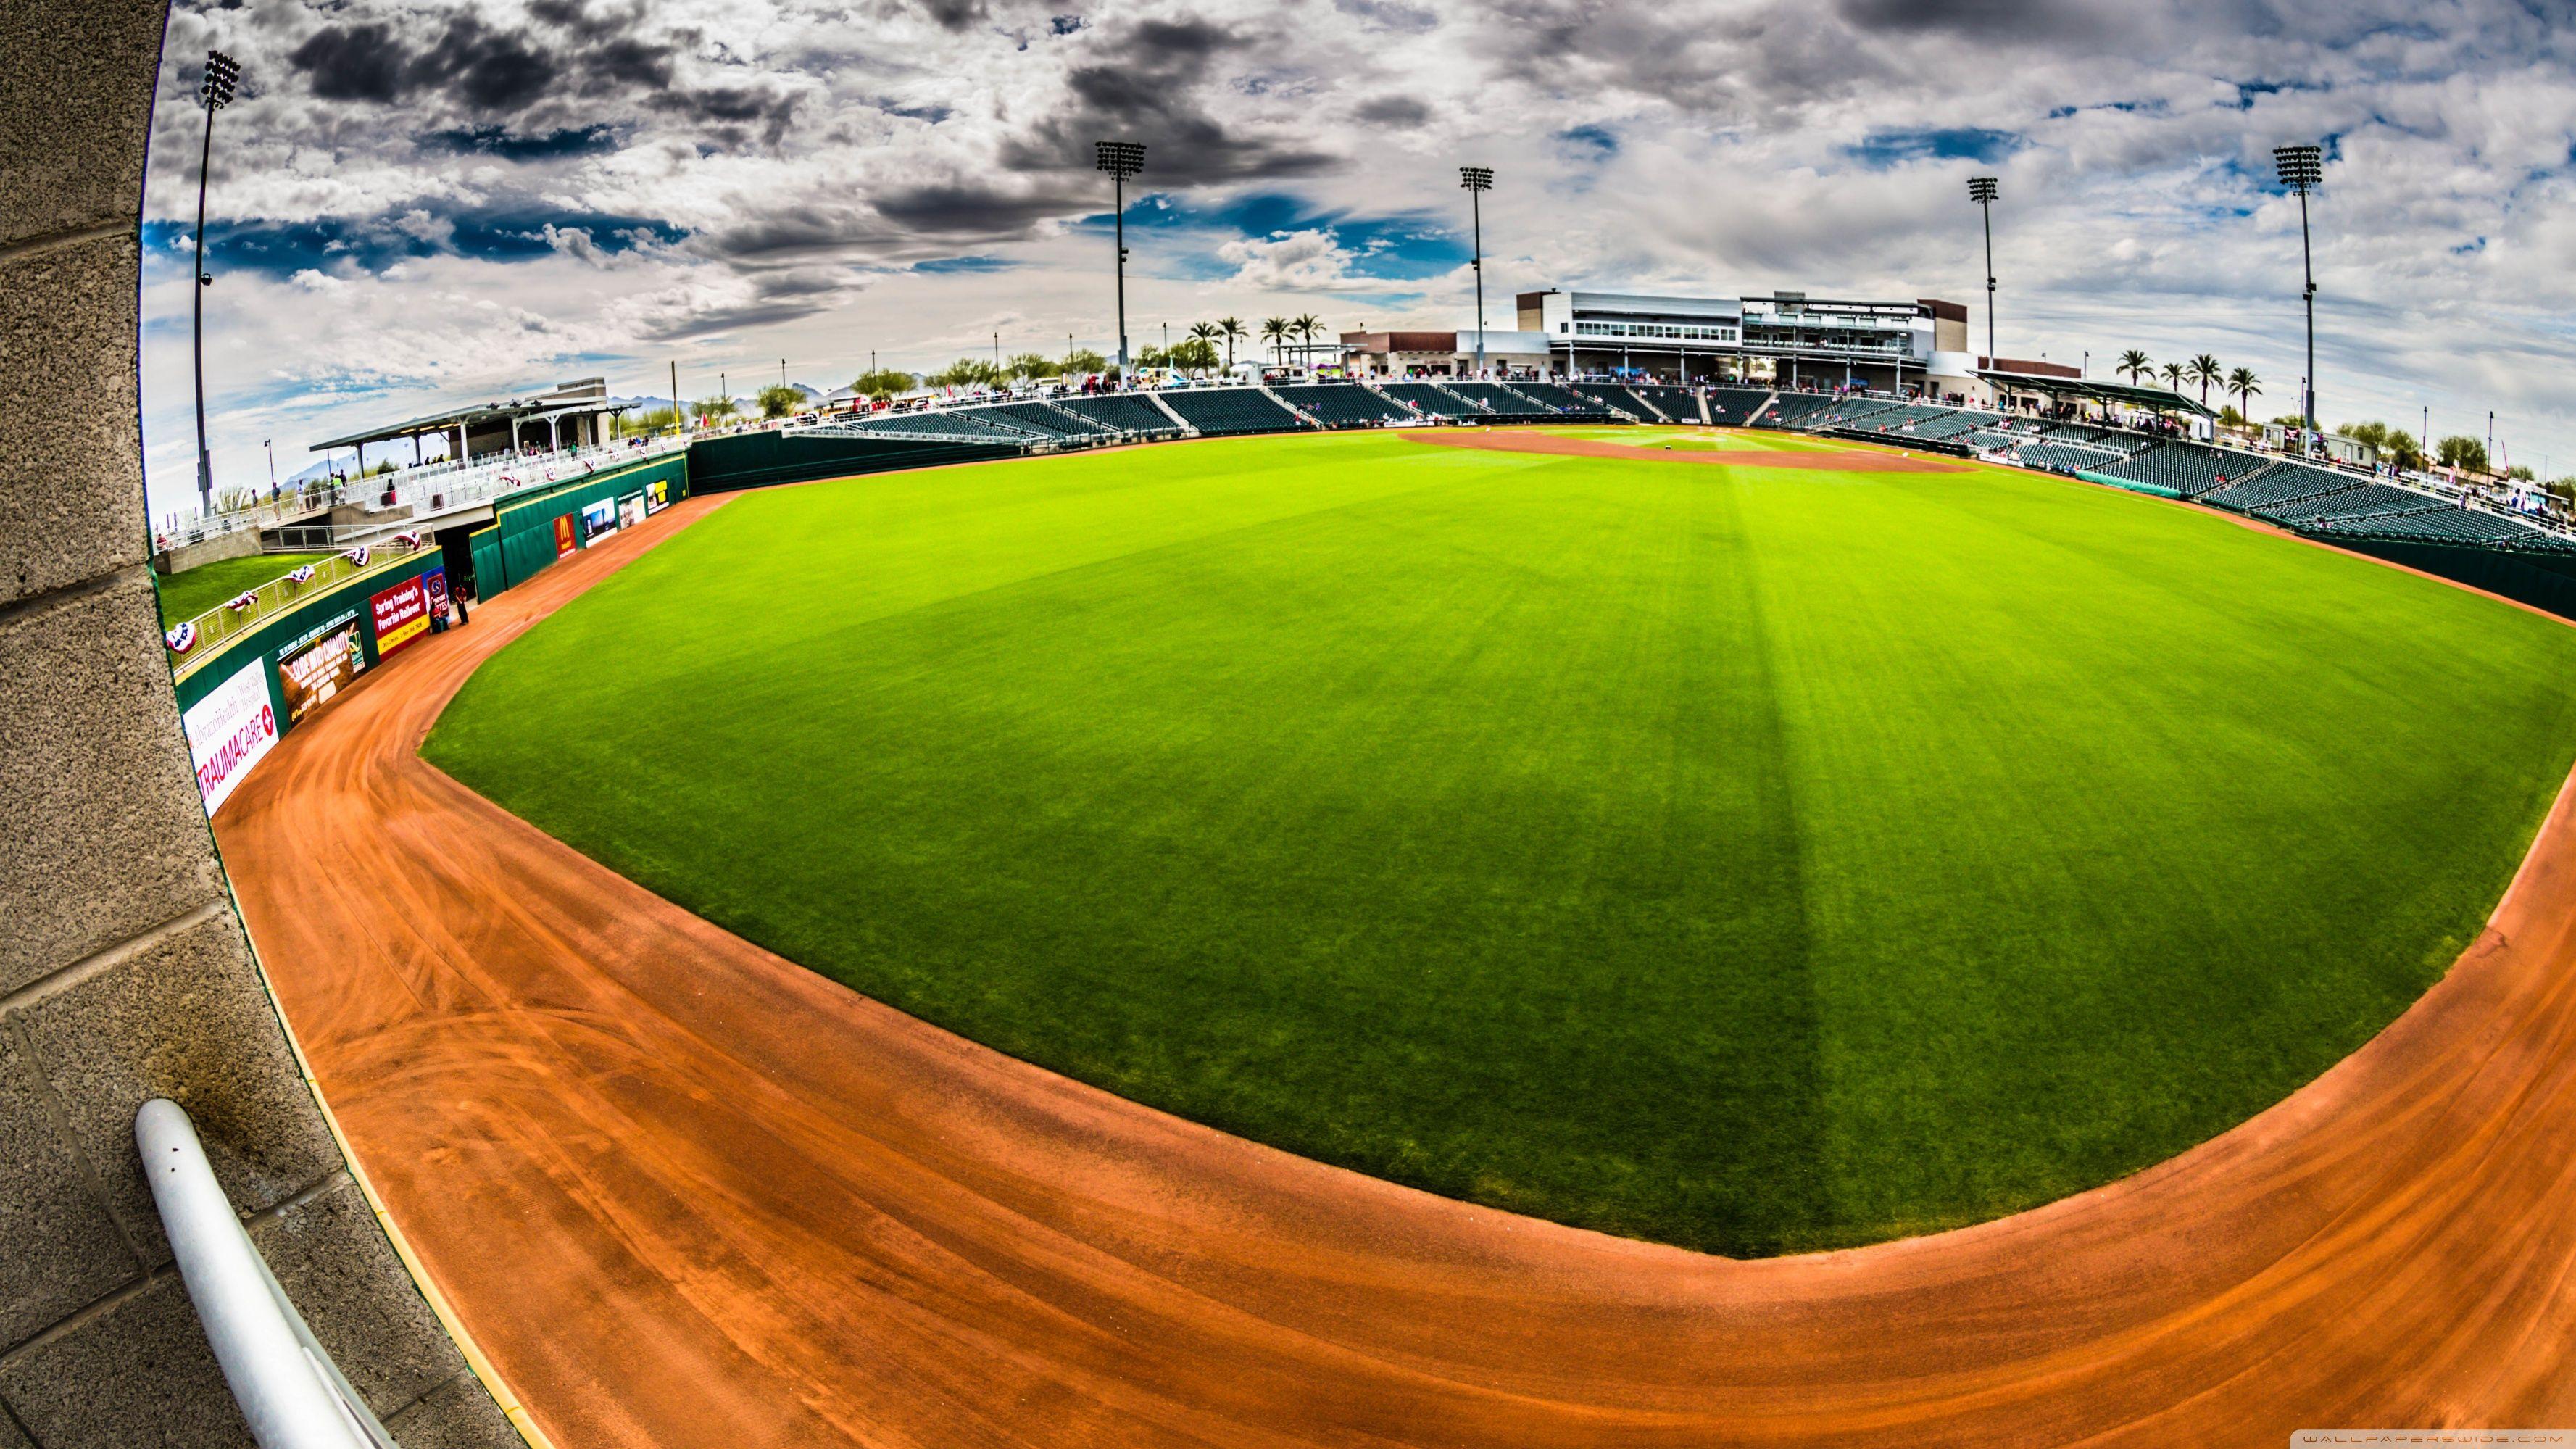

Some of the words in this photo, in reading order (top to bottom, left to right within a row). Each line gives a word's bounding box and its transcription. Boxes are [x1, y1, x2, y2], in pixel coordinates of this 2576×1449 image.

[375, 598, 394, 616] Spring
[392, 586, 419, 606] Training's
[377, 612, 400, 632] Favorite
[399, 602, 420, 620] Reliever
[291, 652, 311, 683] SLIDE
[323, 630, 349, 662] QUALITY
[194, 696, 239, 749] AbrazoHealth
[196, 713, 264, 801] TRAUMACARE
